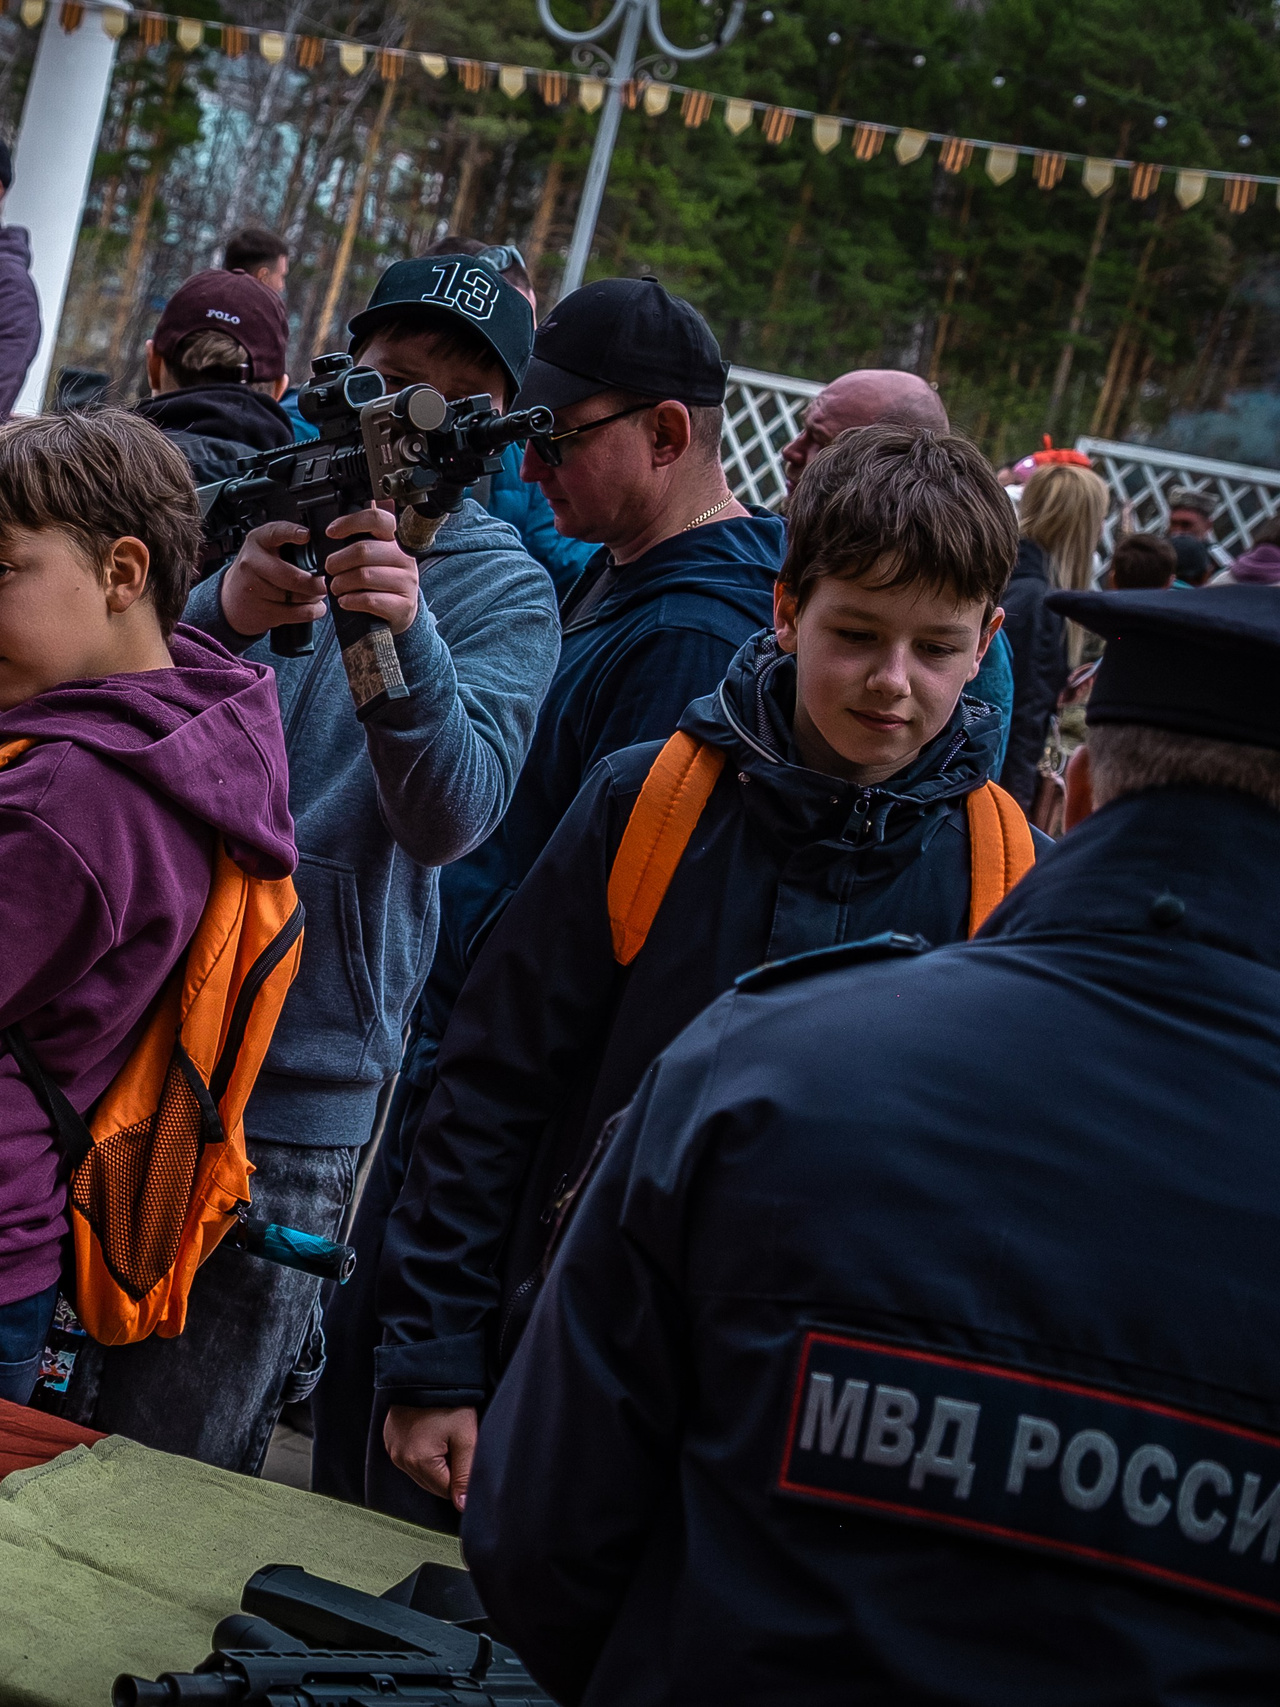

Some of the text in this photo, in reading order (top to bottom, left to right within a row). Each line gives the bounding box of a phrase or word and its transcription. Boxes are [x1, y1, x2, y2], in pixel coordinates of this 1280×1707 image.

[205, 308, 241, 325] POLO
[420, 261, 500, 321] 13
[798, 1371, 982, 1499] МВД
